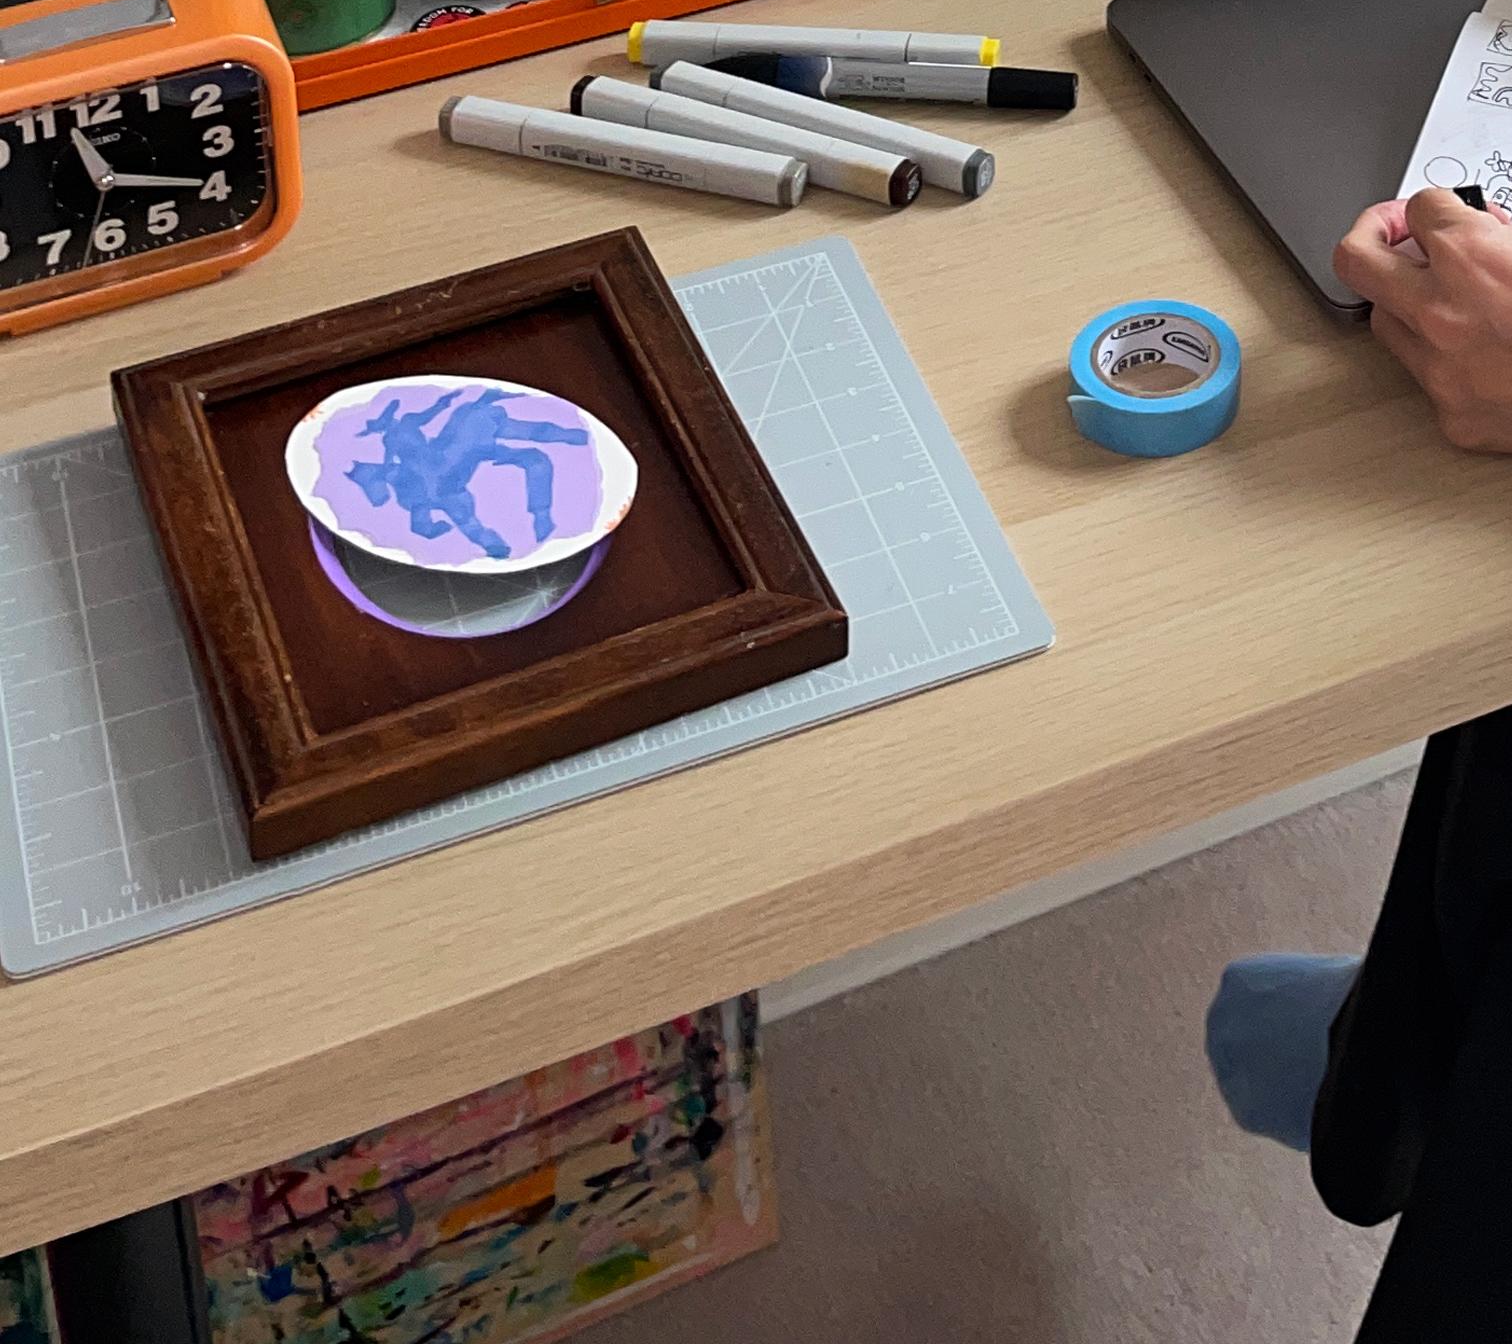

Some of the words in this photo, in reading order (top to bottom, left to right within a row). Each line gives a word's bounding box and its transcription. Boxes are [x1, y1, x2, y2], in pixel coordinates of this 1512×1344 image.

[70, 93, 124, 129] 12
[139, 84, 161, 113] 1
[189, 84, 225, 120] 2
[15, 111, 58, 145] 11
[202, 124, 236, 159] 3
[198, 169, 233, 202] 4
[94, 218, 128, 252] 6
[147, 200, 180, 236] 5
[36, 228, 72, 265] 7
